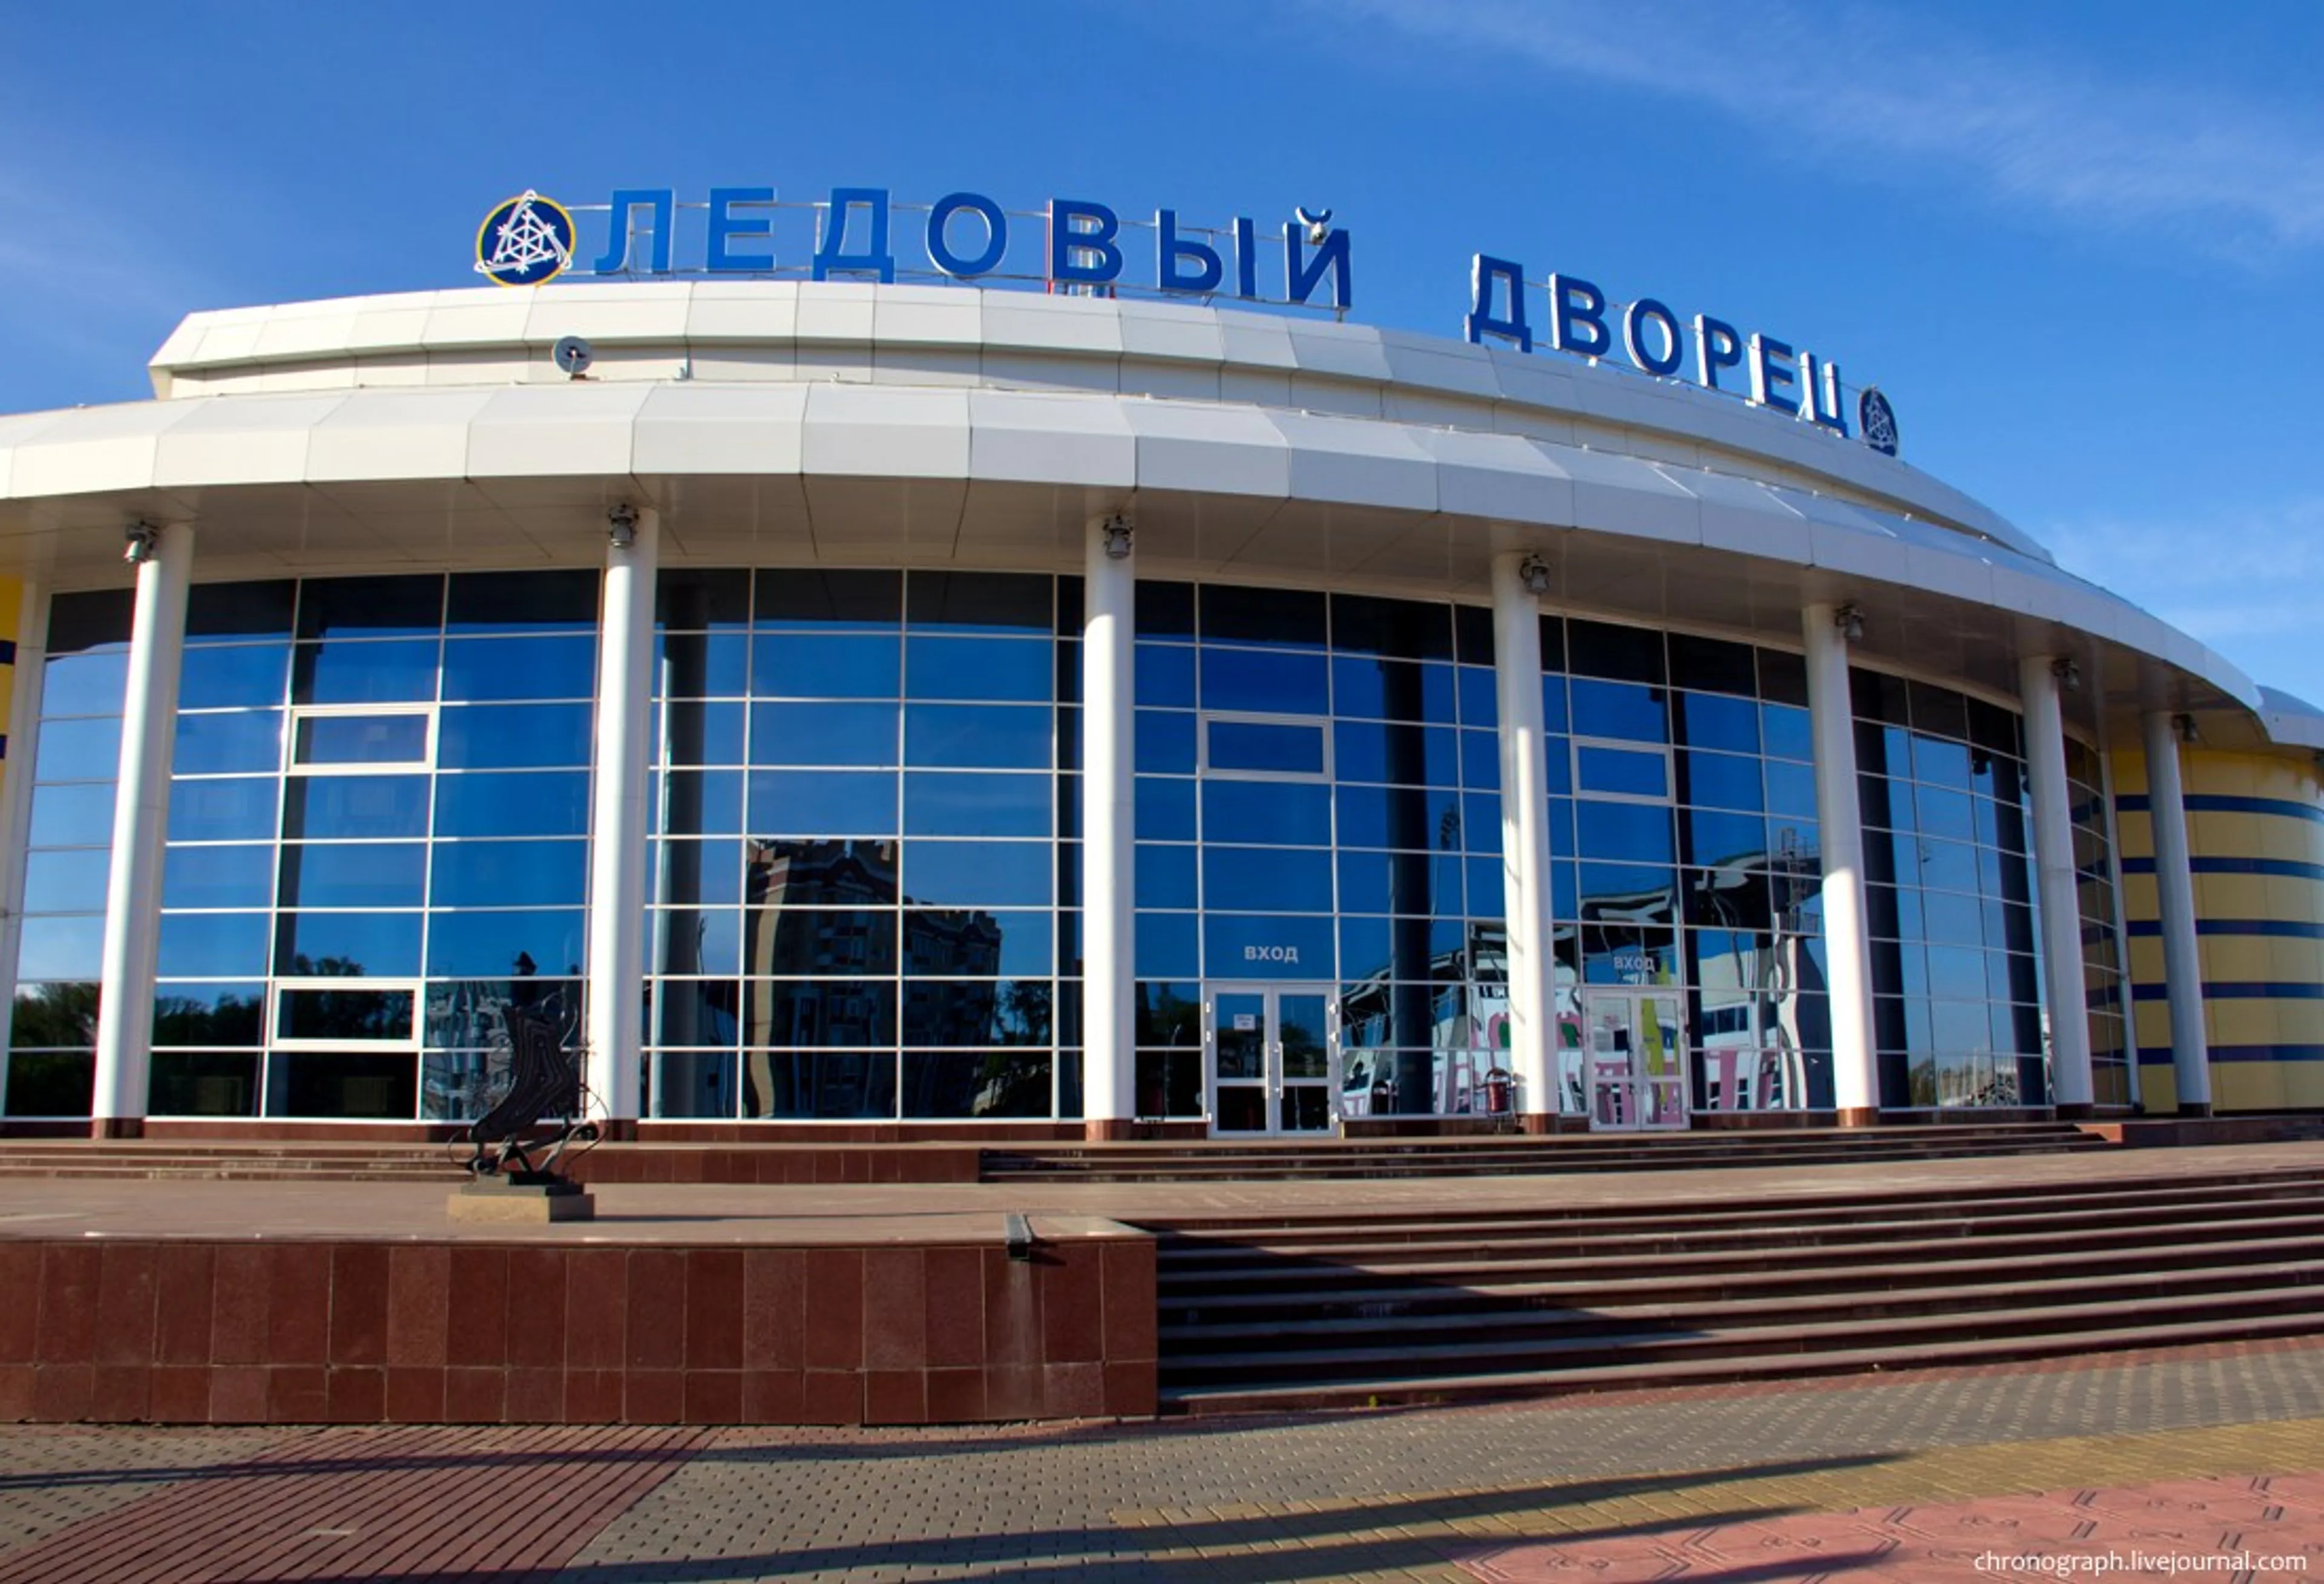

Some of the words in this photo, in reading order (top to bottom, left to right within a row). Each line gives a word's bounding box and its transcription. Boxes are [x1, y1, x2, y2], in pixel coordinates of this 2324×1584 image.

[594, 188, 1351, 309] ЛЕДОВЫЙ
[1464, 253, 1848, 439] ДВОРЕЦ
[1244, 946, 1299, 963] ВХОД
[1613, 957, 1655, 972] ВХОД
